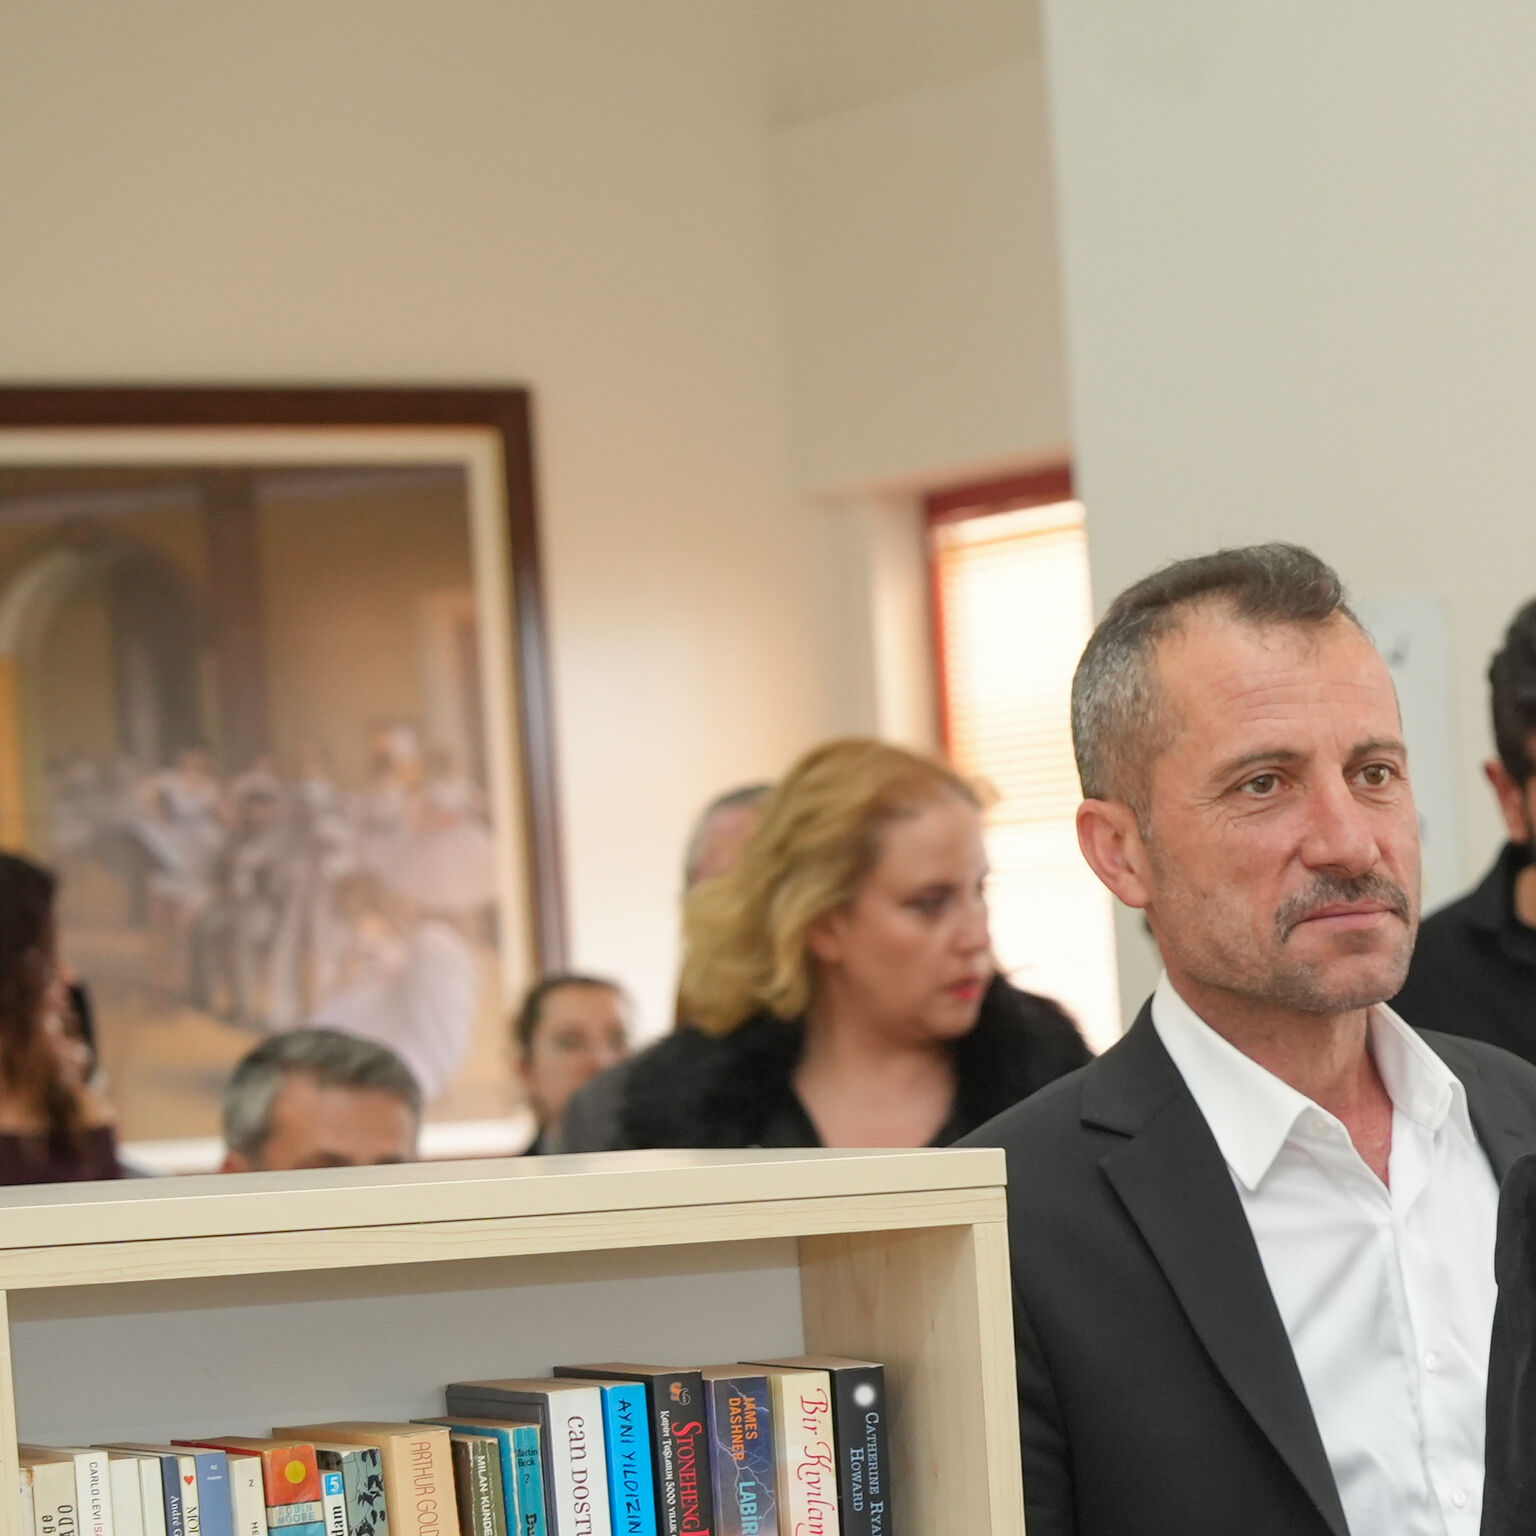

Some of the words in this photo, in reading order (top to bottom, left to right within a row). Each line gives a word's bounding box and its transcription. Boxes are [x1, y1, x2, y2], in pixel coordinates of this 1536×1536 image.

[618, 1399, 633, 1444] AYNI
[728, 1397, 746, 1461] DASHNER
[743, 1397, 758, 1440] JAMES
[800, 1388, 829, 1436] Bir
[567, 1415, 587, 1463] can
[865, 1412, 880, 1495] CATHERINE
[410, 1441, 435, 1497] ARTHUR
[476, 1455, 488, 1492] MILAN
[621, 1451, 643, 1534] YILDIZIN
[850, 1447, 864, 1512] HOWARD
[170, 1496, 182, 1526] André
